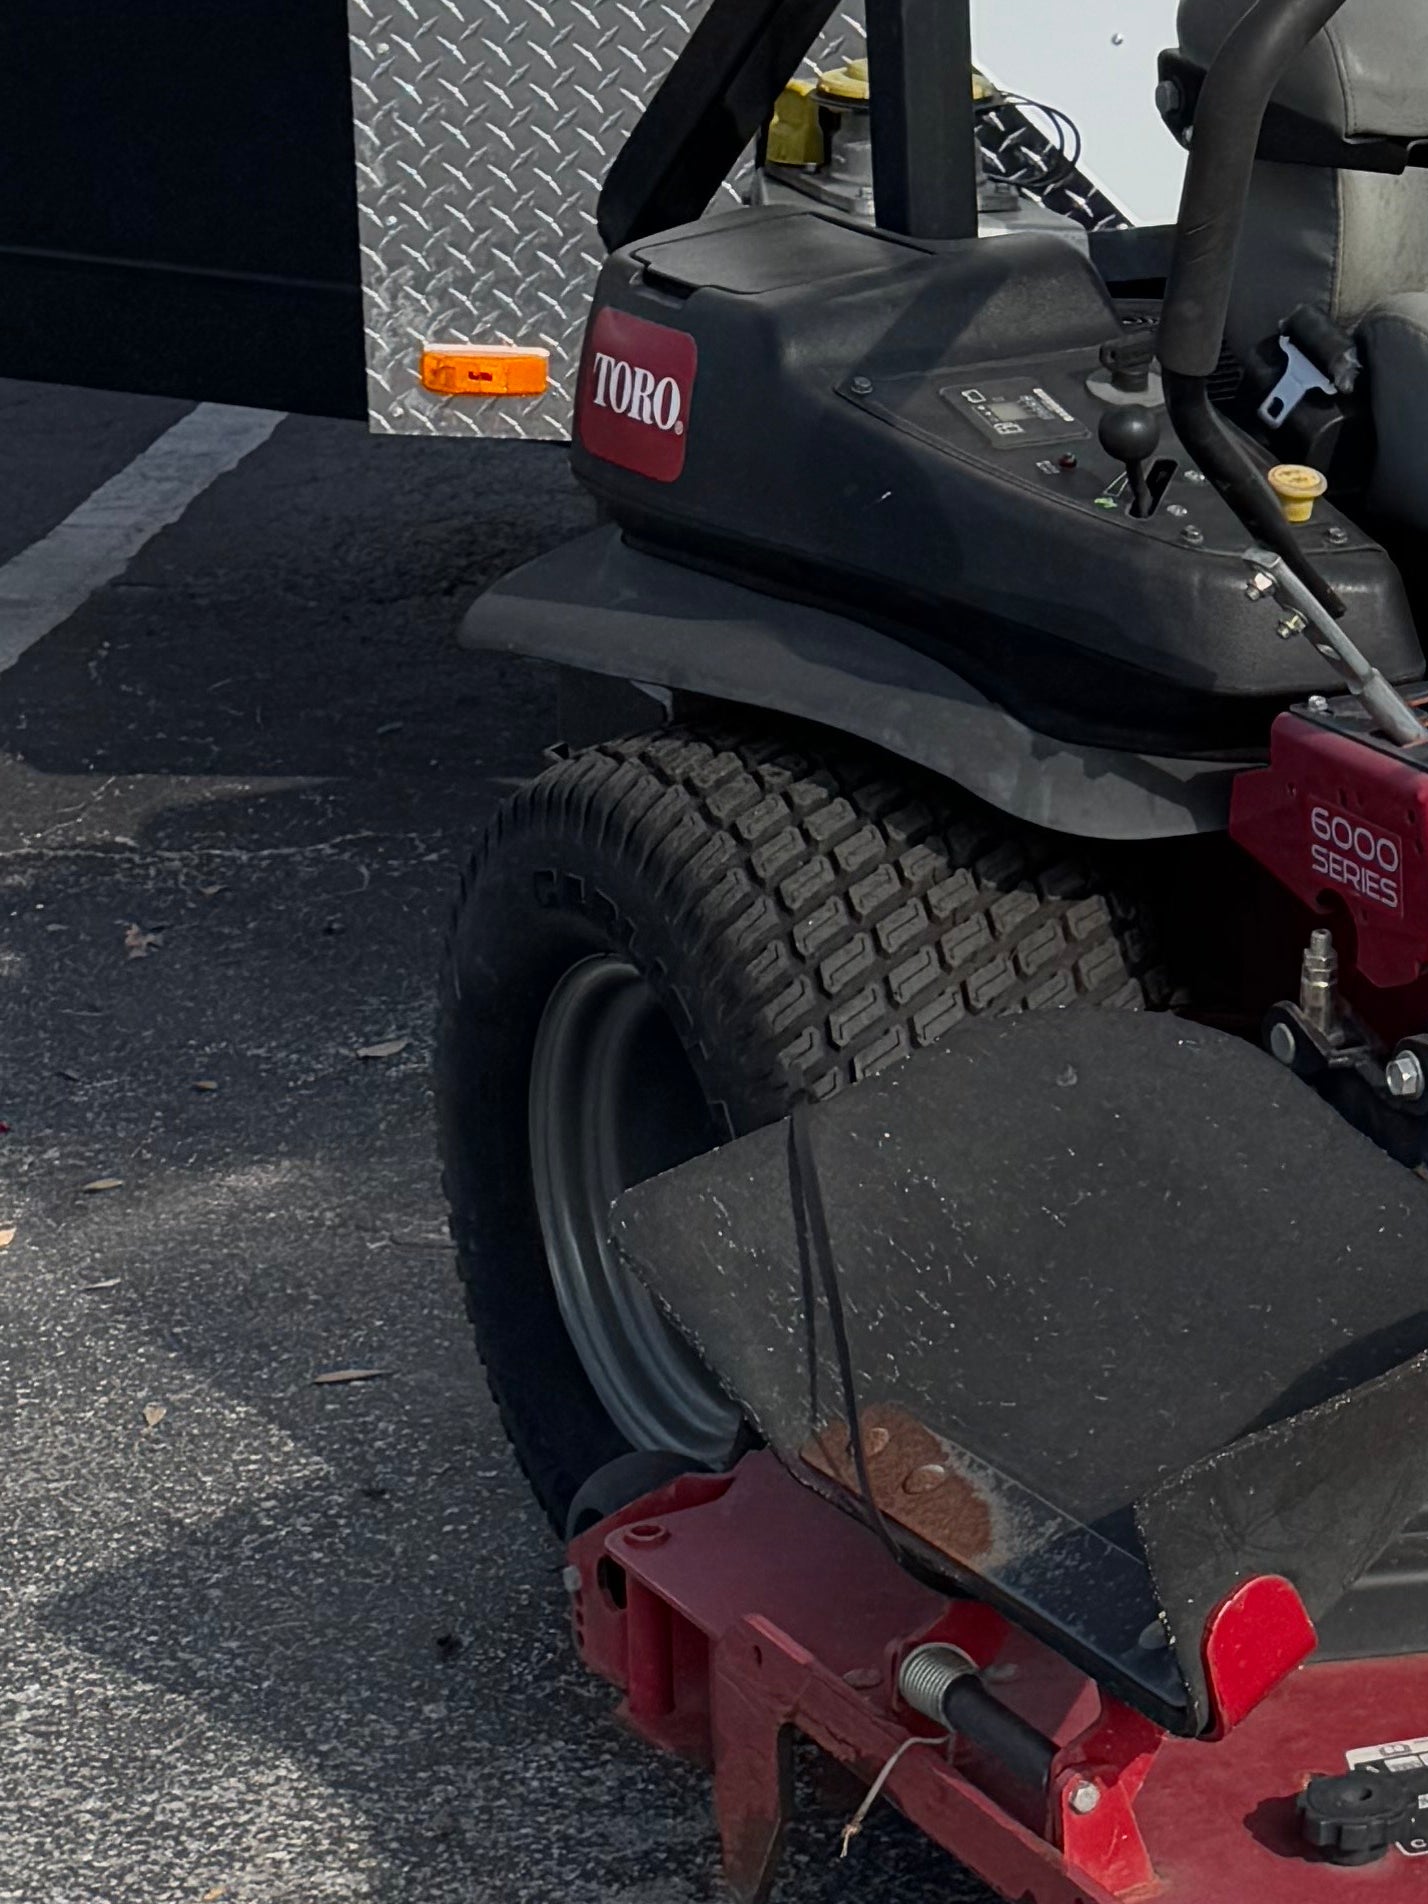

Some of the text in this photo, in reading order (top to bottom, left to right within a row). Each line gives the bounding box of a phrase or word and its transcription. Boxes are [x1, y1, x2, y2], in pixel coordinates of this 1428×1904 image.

[593, 352, 681, 431] TORO
[1311, 806, 1399, 872] 6000
[1311, 844, 1399, 908] SERIES
